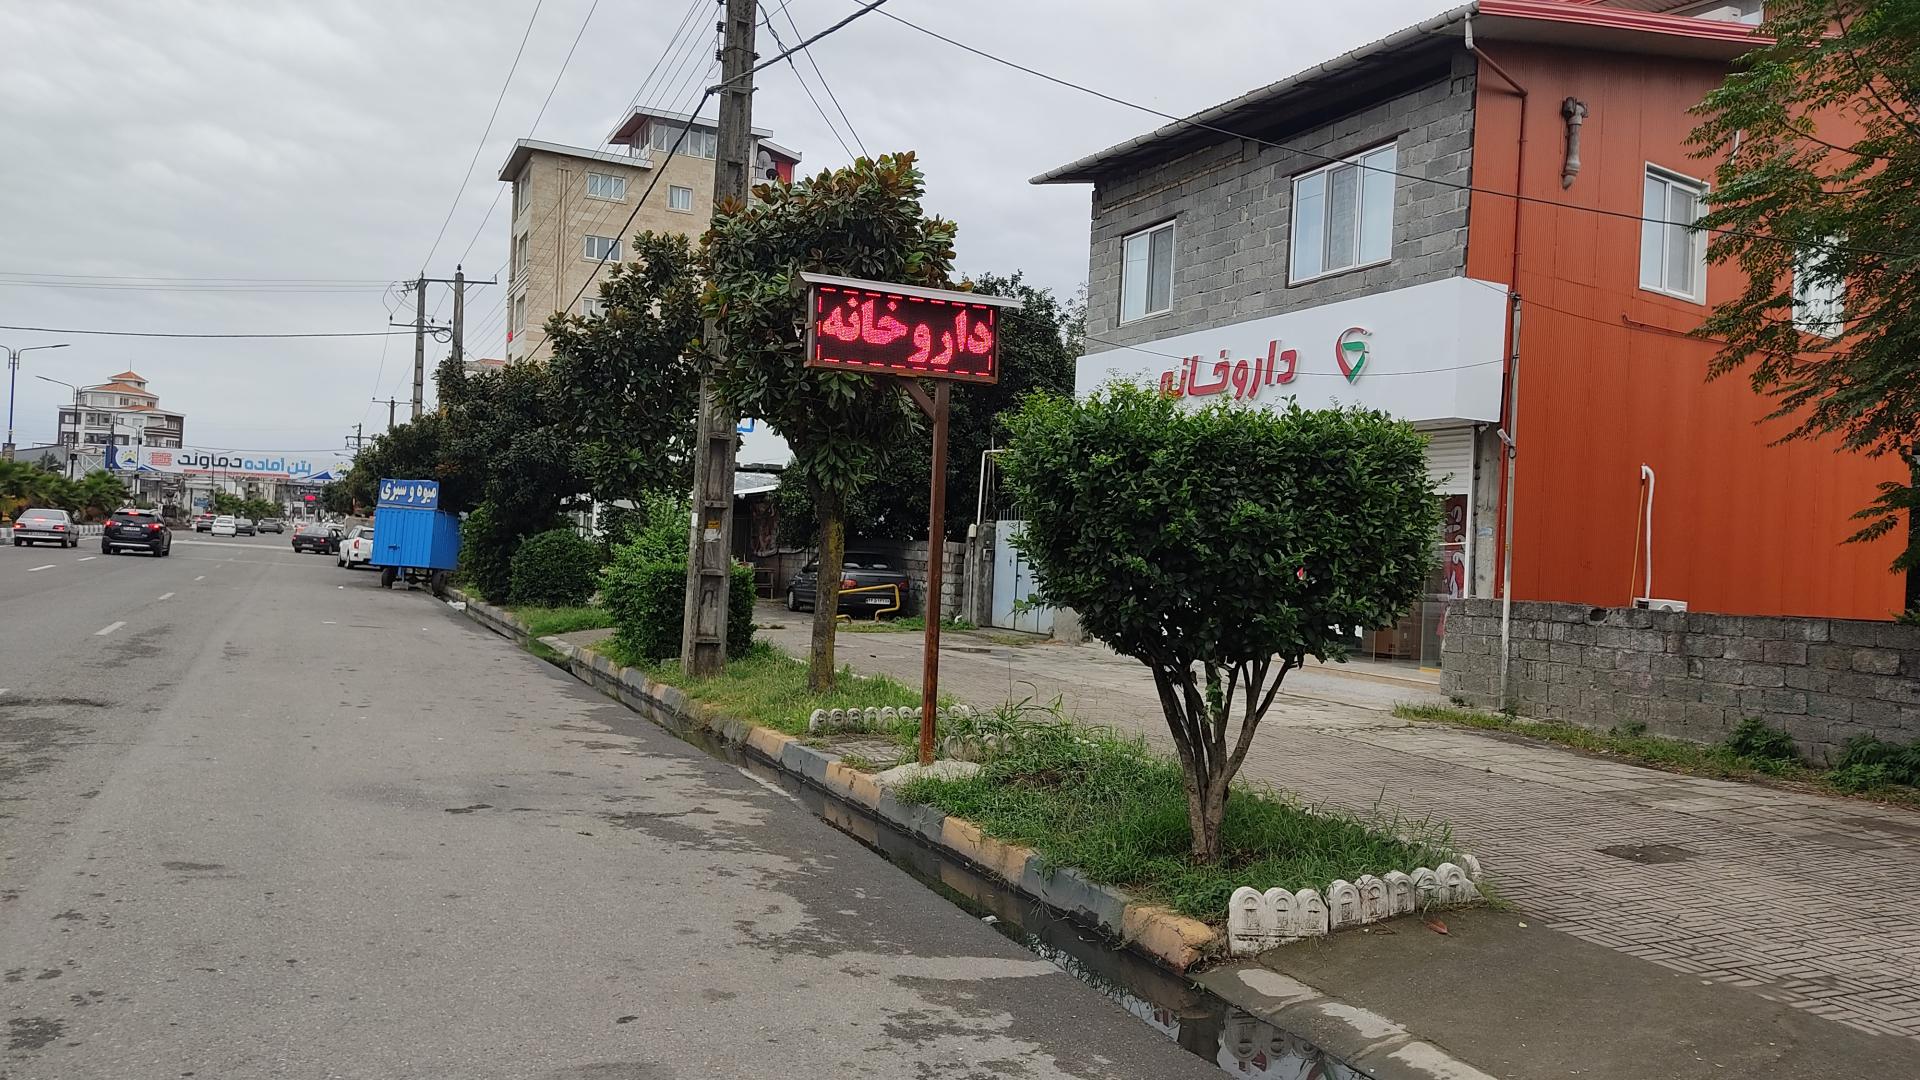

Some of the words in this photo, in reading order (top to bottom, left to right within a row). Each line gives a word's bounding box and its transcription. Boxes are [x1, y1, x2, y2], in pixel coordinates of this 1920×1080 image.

[822, 297, 992, 365] داروخانه
[1159, 340, 1298, 401] داروخانه
[177, 453, 242, 469] دماوند
[287, 460, 312, 475] بتن
[380, 480, 407, 501] سبزی
[407, 486, 415, 503] و
[416, 484, 437, 504] میوه
